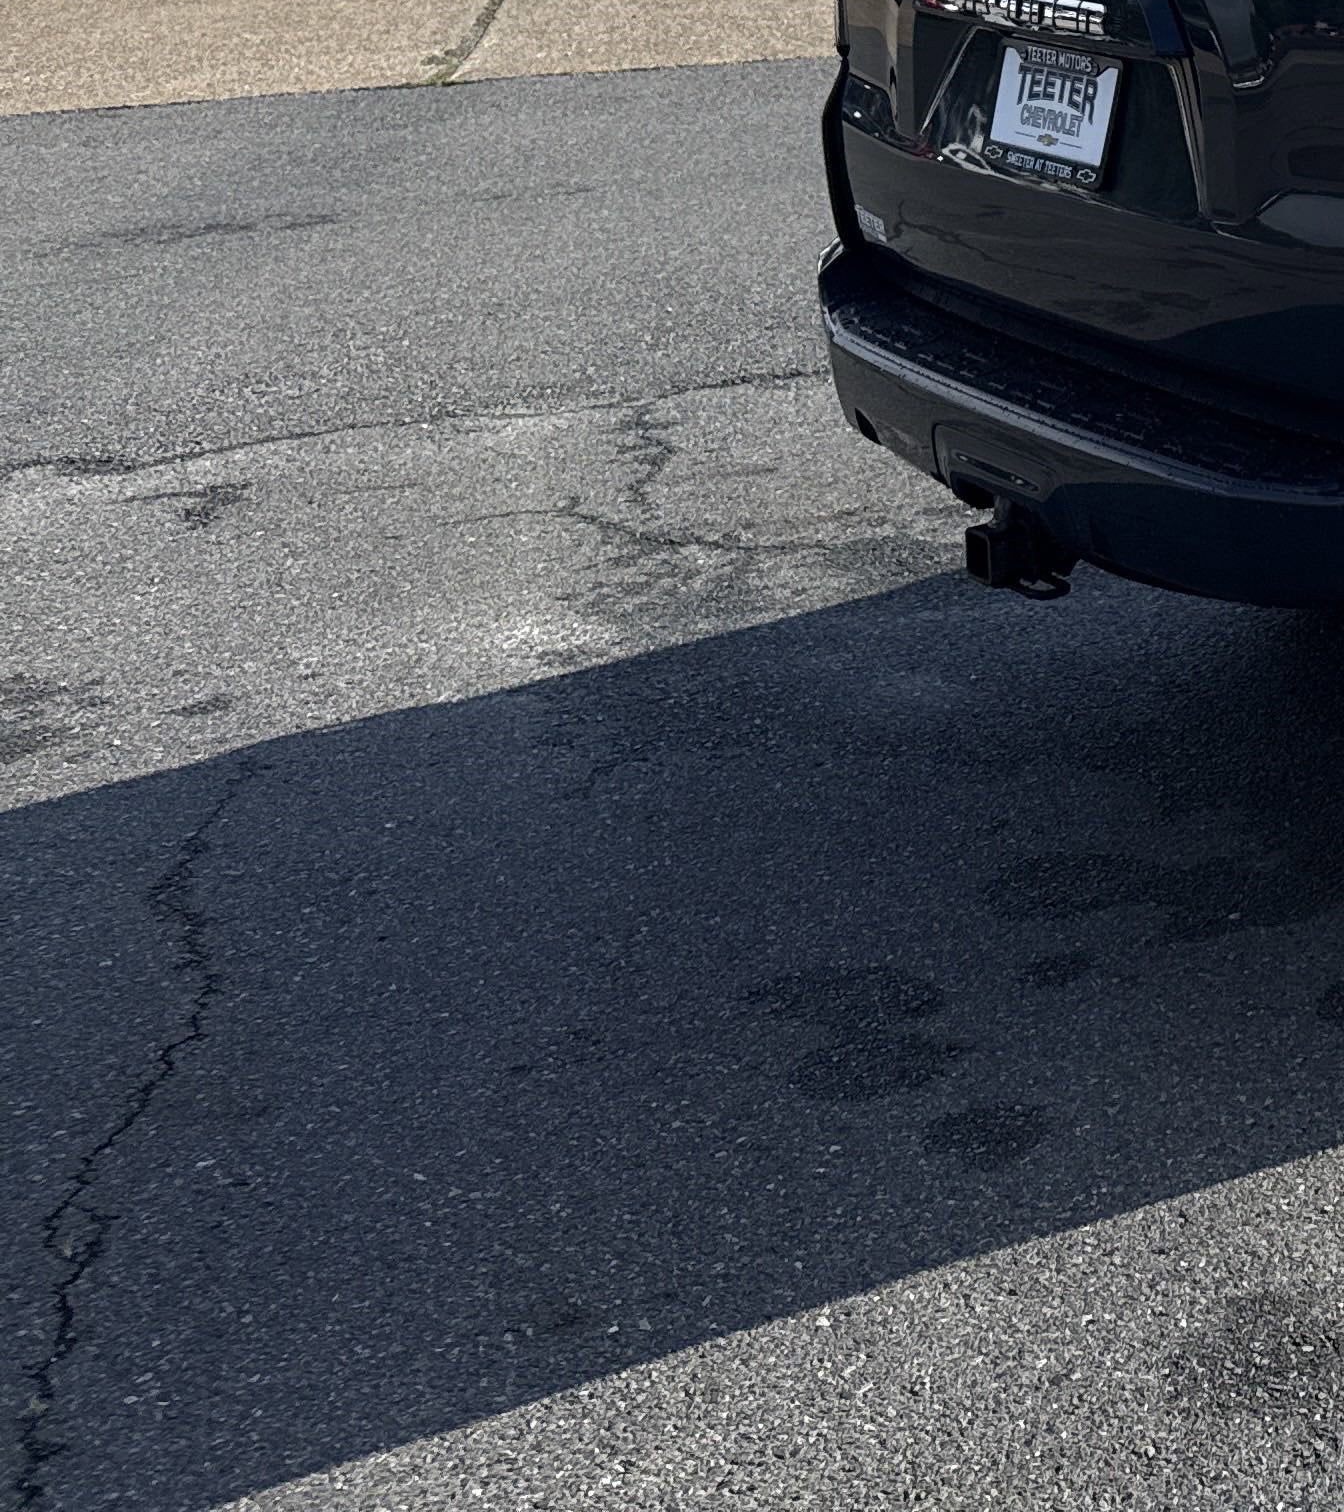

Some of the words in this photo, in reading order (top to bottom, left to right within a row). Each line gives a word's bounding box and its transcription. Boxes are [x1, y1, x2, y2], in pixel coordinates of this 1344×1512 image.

[1026, 45, 1057, 66] TEETER
[1058, 51, 1094, 73] MOTORS
[1016, 63, 1099, 126] TEETER
[1020, 103, 1085, 138] CHEVROLET
[1005, 150, 1035, 170] SWEETER
[1034, 158, 1045, 171] AT
